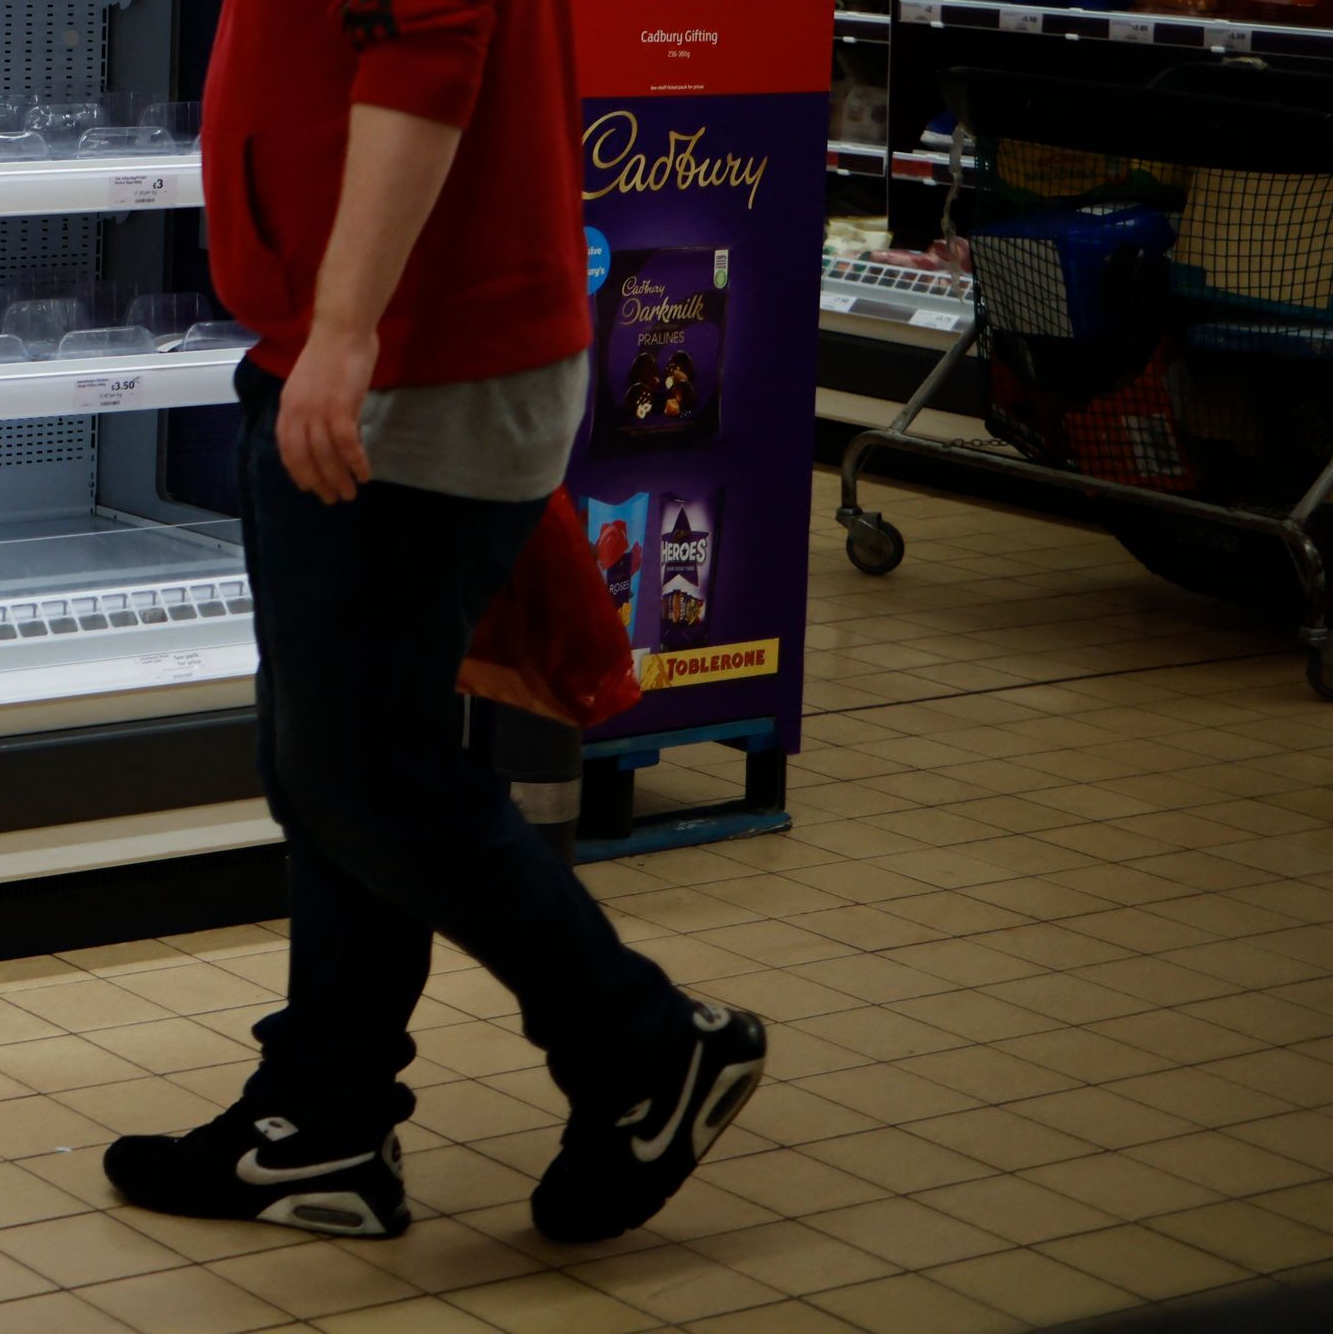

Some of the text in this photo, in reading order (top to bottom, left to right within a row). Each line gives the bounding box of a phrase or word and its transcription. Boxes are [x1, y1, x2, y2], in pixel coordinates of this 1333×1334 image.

[640, 28, 719, 46] Cadbury Gifting
[581, 110, 769, 210] Cadbury
[153, 178, 163, 190] £3
[621, 275, 666, 297] Cadbury
[618, 293, 705, 326] Darkmilk
[637, 330, 685, 346] PRALINES
[111, 380, 135, 391] £3.50
[661, 539, 708, 563] HEROES
[609, 579, 630, 595] ROSES
[666, 649, 766, 681] TOBLERONE
